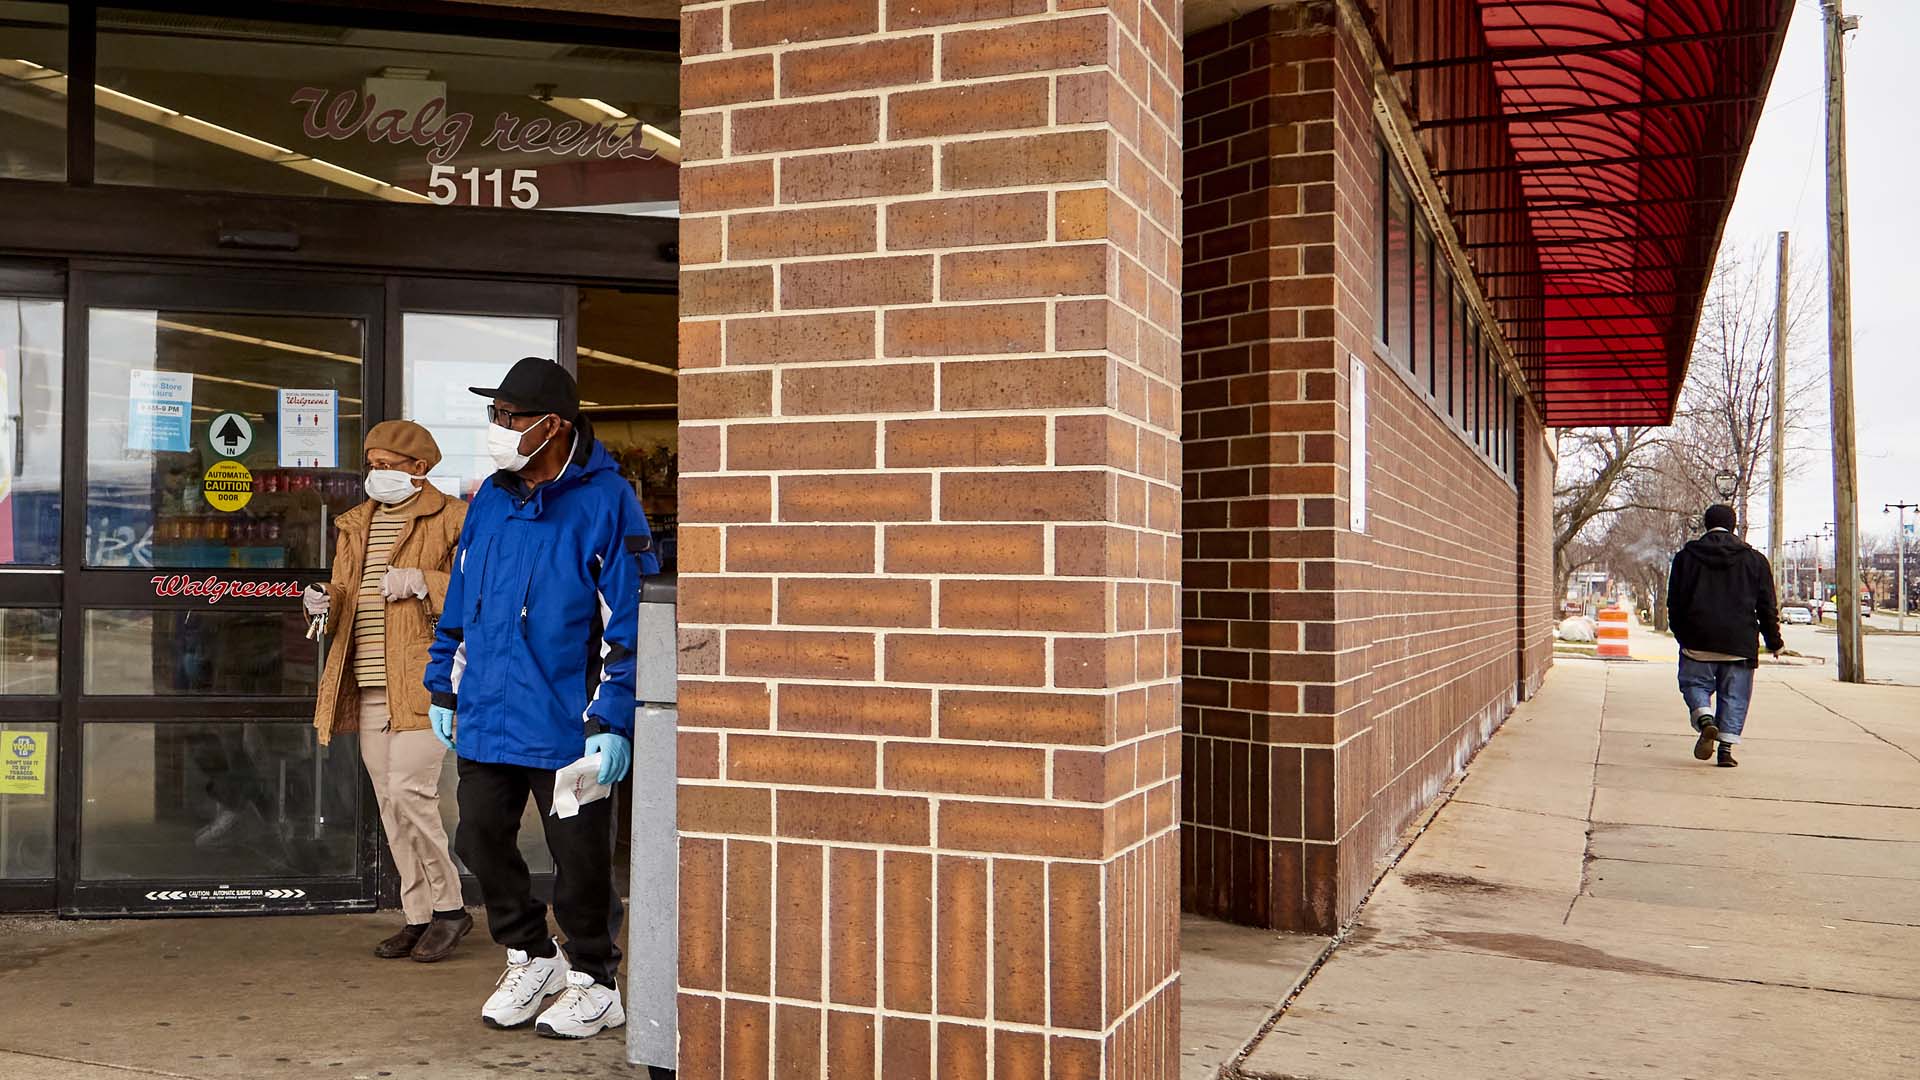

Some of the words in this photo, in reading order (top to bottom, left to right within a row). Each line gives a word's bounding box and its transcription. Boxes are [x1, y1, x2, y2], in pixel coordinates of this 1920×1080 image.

[427, 165, 540, 210] 5115
[160, 382, 183, 391] Store
[286, 396, 328, 407] Walgreens
[167, 405, 180, 413] PM
[226, 447, 236, 455] IN
[208, 471, 250, 480] AUTOMATIC
[205, 481, 250, 491] CAUTION
[151, 575, 304, 604] Walgreens
